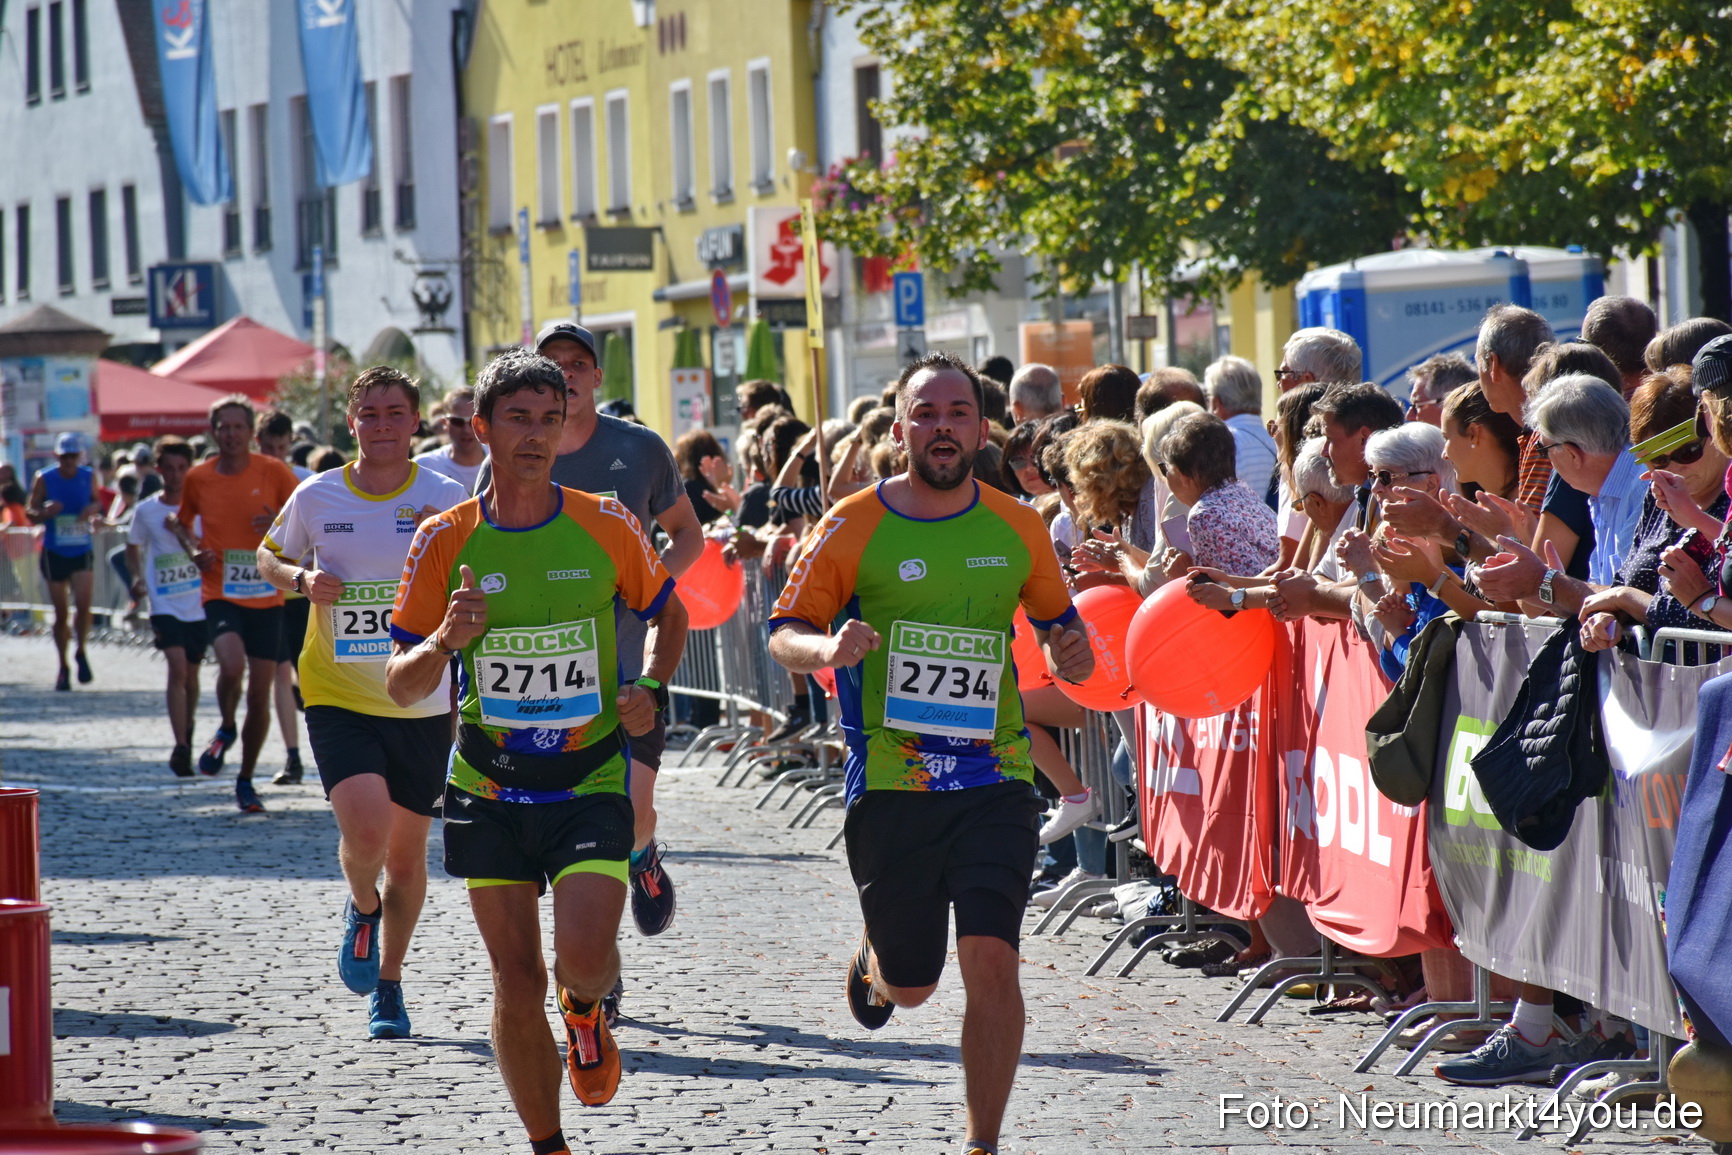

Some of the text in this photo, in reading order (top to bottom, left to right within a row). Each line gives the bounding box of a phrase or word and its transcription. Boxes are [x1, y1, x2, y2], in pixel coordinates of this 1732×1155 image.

[590, 252, 650, 267] TAIFUN
[901, 278, 919, 322] P
[397, 508, 415, 519] 20
[324, 523, 354, 531] BOCK
[966, 557, 1008, 568] BOCK
[159, 566, 198, 584] 2249
[230, 566, 262, 581] 244
[547, 569, 591, 581] BOCK
[482, 625, 587, 654] BOCK
[899, 626, 997, 660] BOCK
[490, 660, 585, 694] 2714
[900, 661, 989, 701] 2734
[516, 694, 561, 706] Martin
